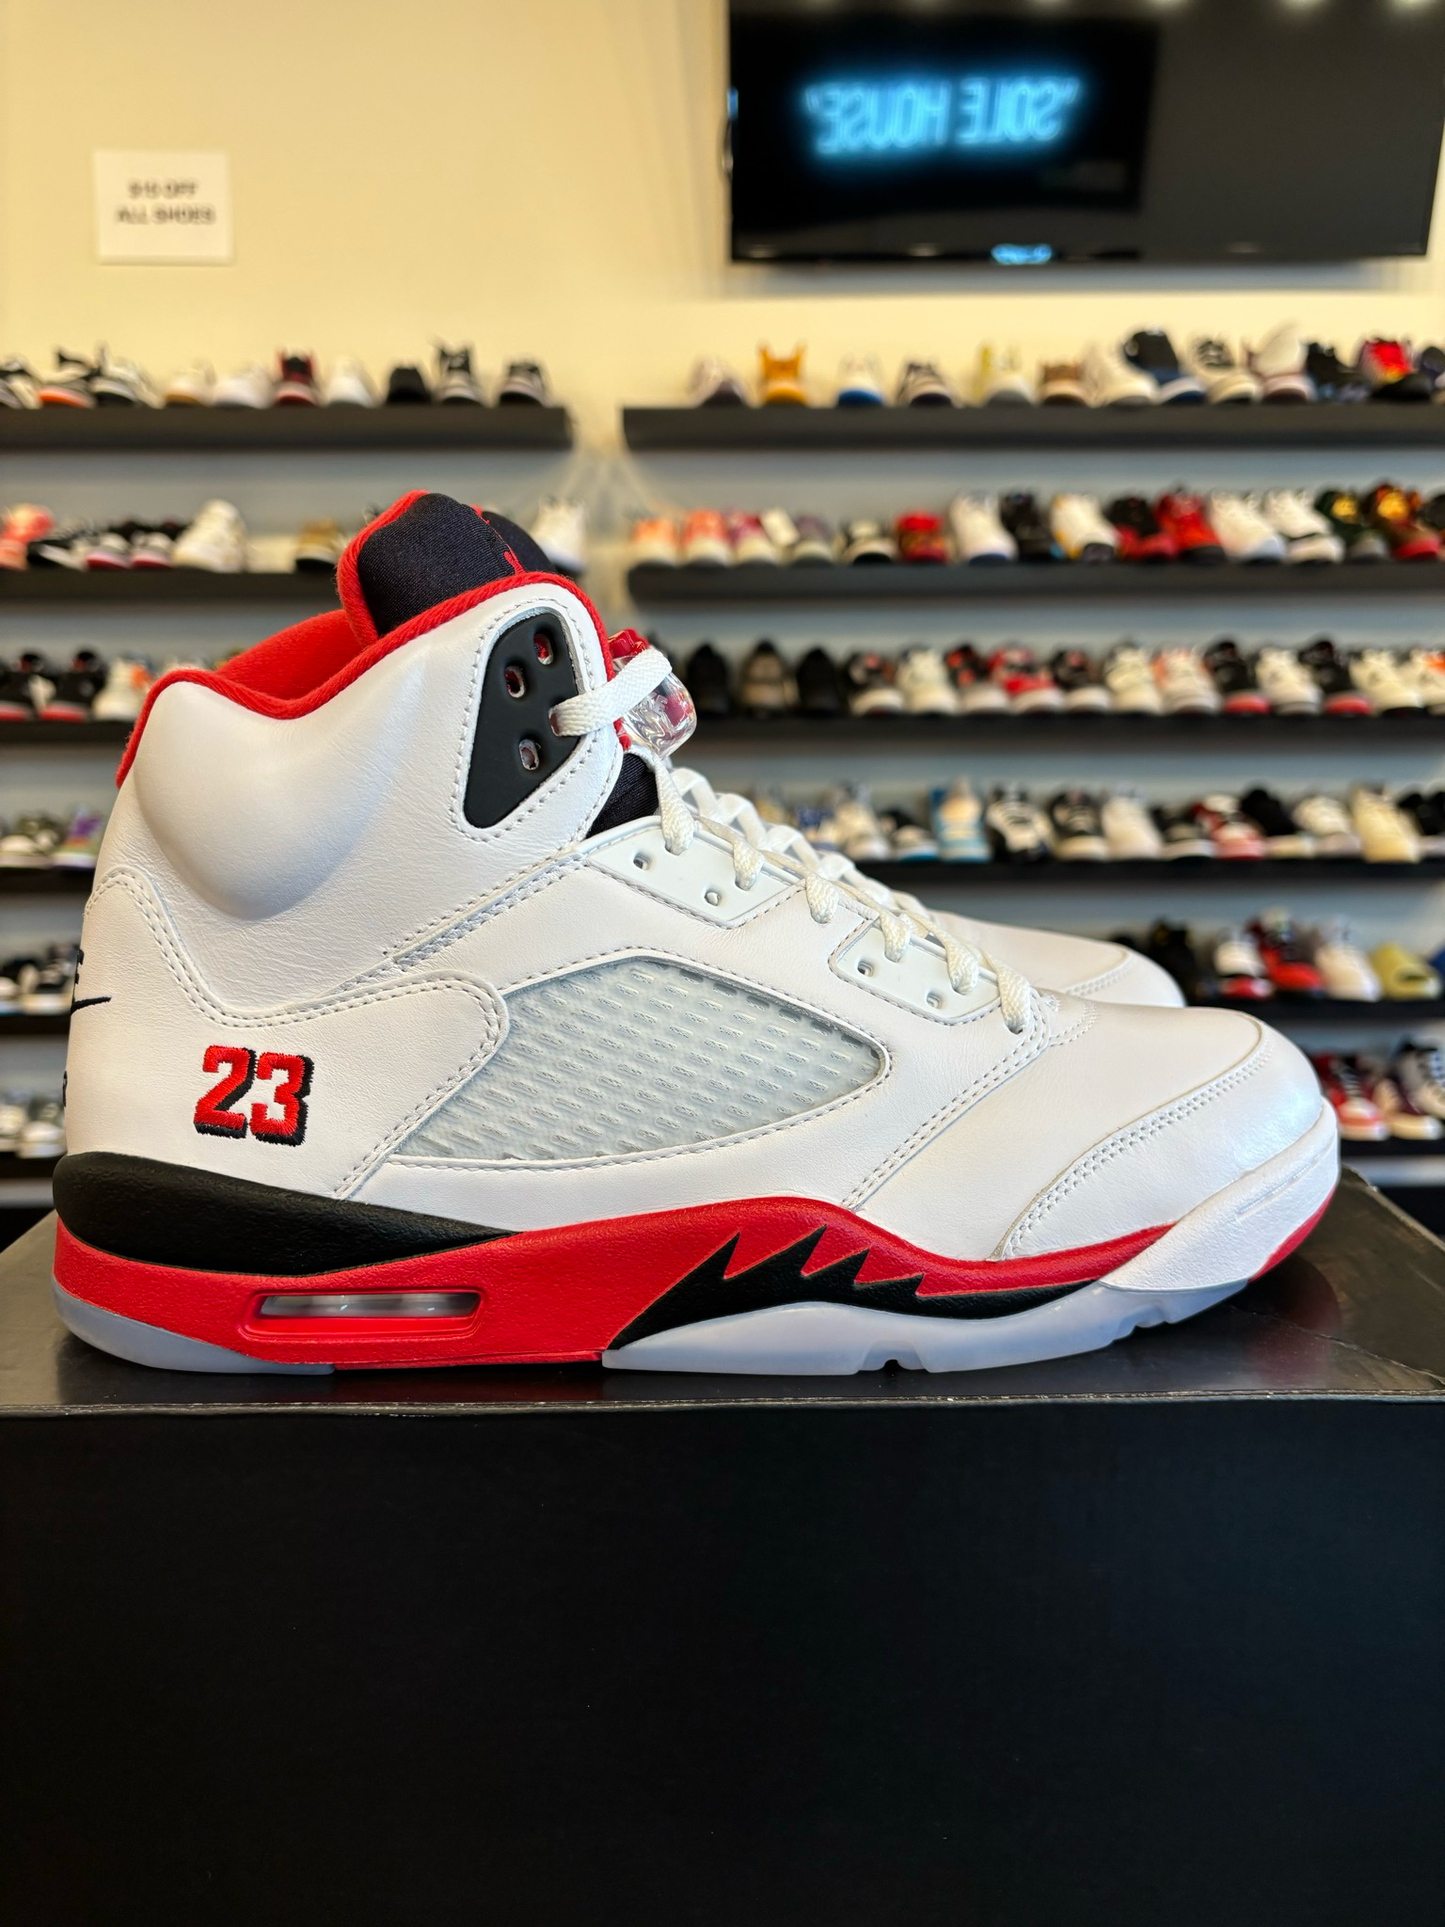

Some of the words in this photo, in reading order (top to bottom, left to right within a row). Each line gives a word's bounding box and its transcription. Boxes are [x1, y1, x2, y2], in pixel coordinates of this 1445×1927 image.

[162, 179, 198, 199] OFF
[115, 204, 148, 225] ALL
[150, 204, 216, 225] SHOES
[193, 1045, 315, 1147] 23
